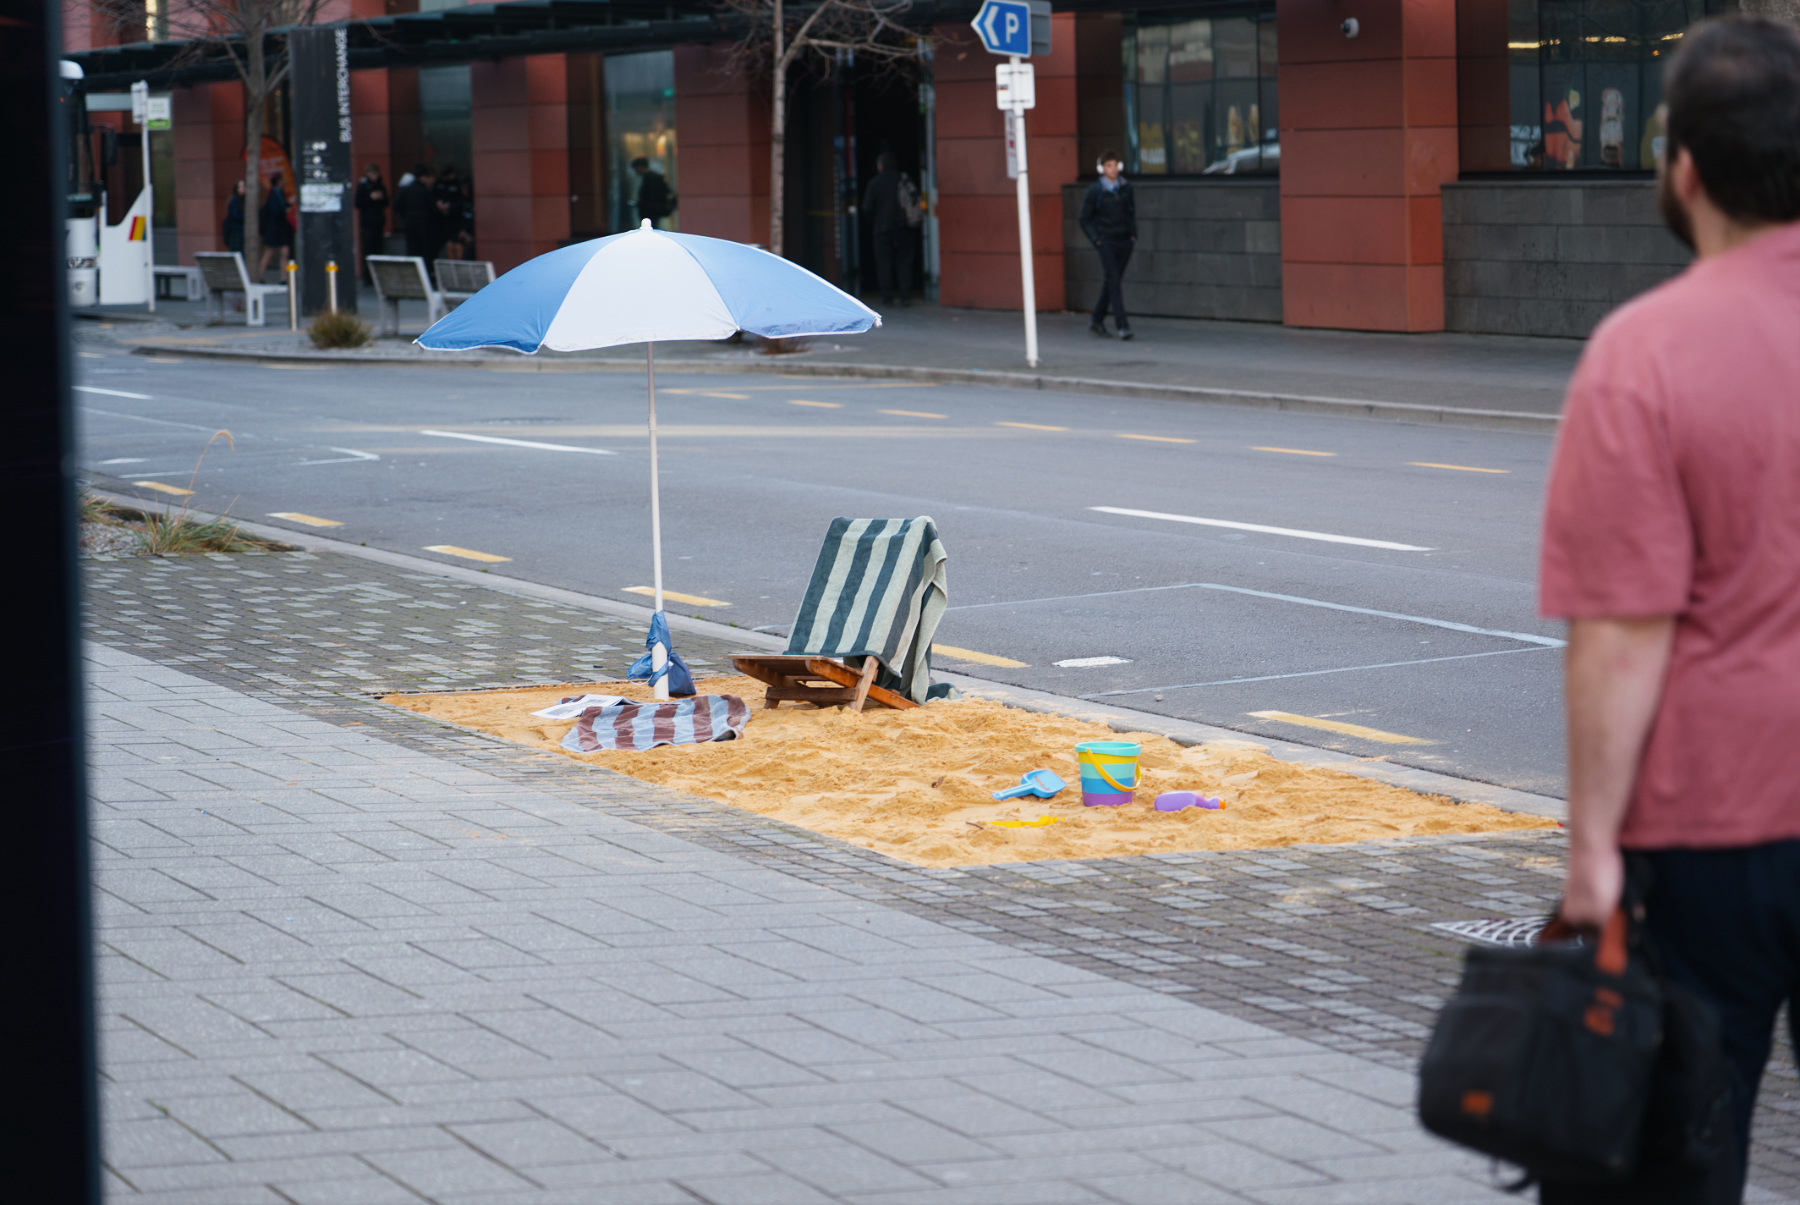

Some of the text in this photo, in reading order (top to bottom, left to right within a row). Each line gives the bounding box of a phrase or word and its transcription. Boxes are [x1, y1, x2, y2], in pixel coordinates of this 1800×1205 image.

[1005, 12, 1019, 43] P
[335, 28, 352, 142] BUS INTERCHANGE
